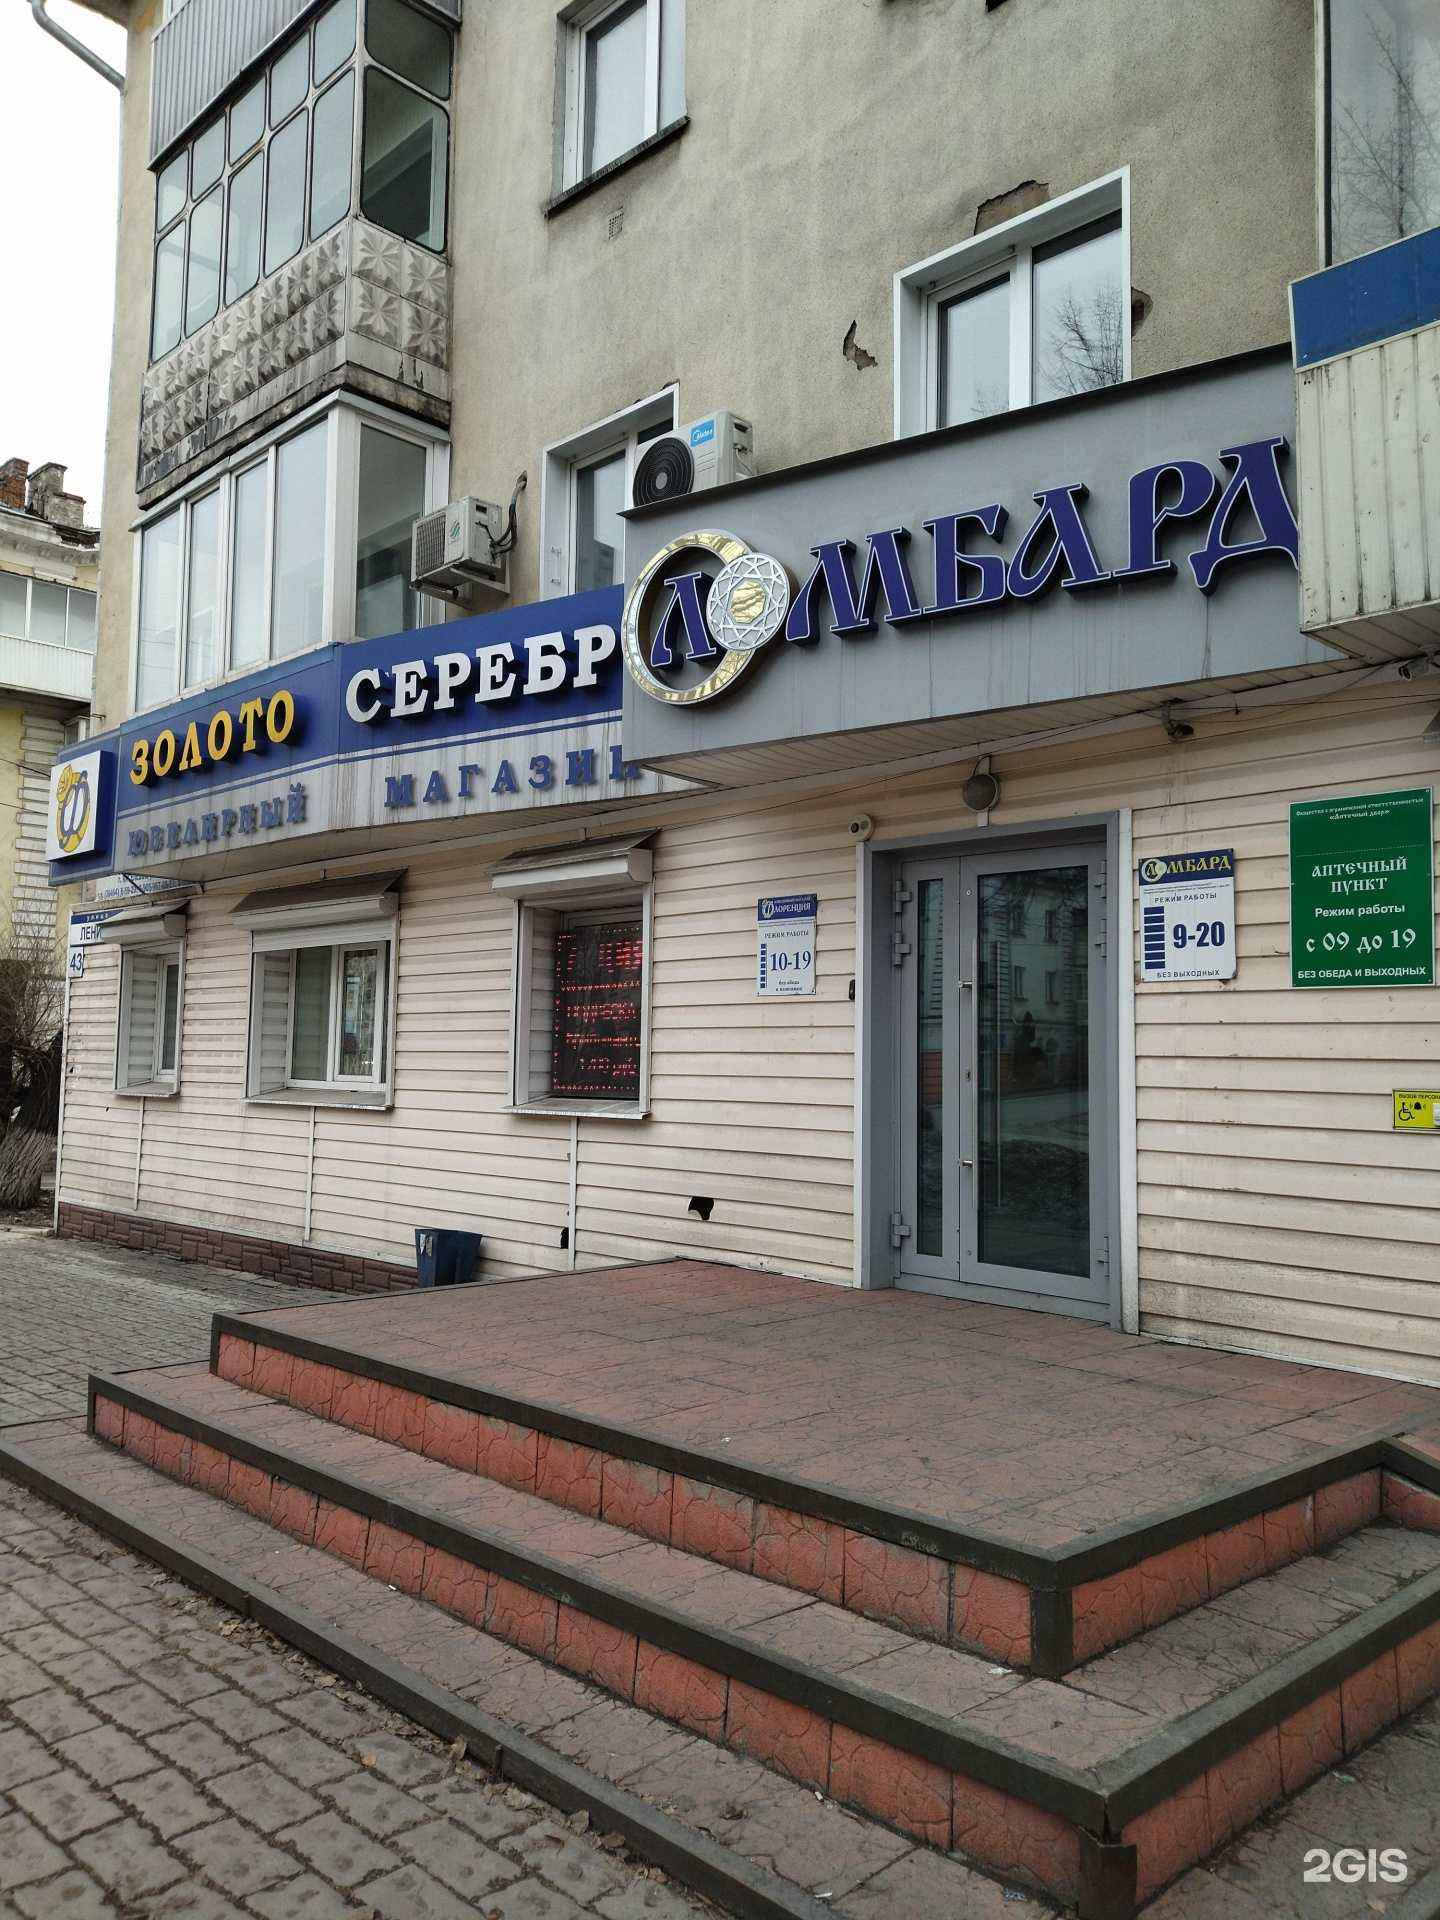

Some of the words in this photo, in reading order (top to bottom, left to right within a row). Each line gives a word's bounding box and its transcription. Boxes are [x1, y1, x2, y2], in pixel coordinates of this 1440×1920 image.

[623, 436, 1299, 706] ЛОМБАРД
[345, 624, 616, 723] СЕРЕБР
[129, 689, 295, 785] ЗОЛОТО
[127, 782, 307, 857] ЮВЕЛИРНЫЙ
[1154, 894, 1182, 904] РЕЖИМ
[1184, 892, 1217, 901] РАБОТЫ
[1315, 907, 1354, 917] Режим
[1358, 904, 1405, 916] работы
[1173, 921, 1225, 948] 9-20
[1322, 931, 1350, 951] 09
[1356, 935, 1383, 954] до
[1390, 928, 1416, 949] 19
[70, 953, 82, 971] 43
[770, 950, 811, 971] 10-19
[1173, 969, 1220, 978] ВЫХОДНЫХ
[1298, 970, 1316, 979] БЕЗ
[1318, 969, 1353, 979] ОБЕДА
[1355, 968, 1362, 977] И
[1364, 966, 1426, 977] ВЫХОДНЫХ
